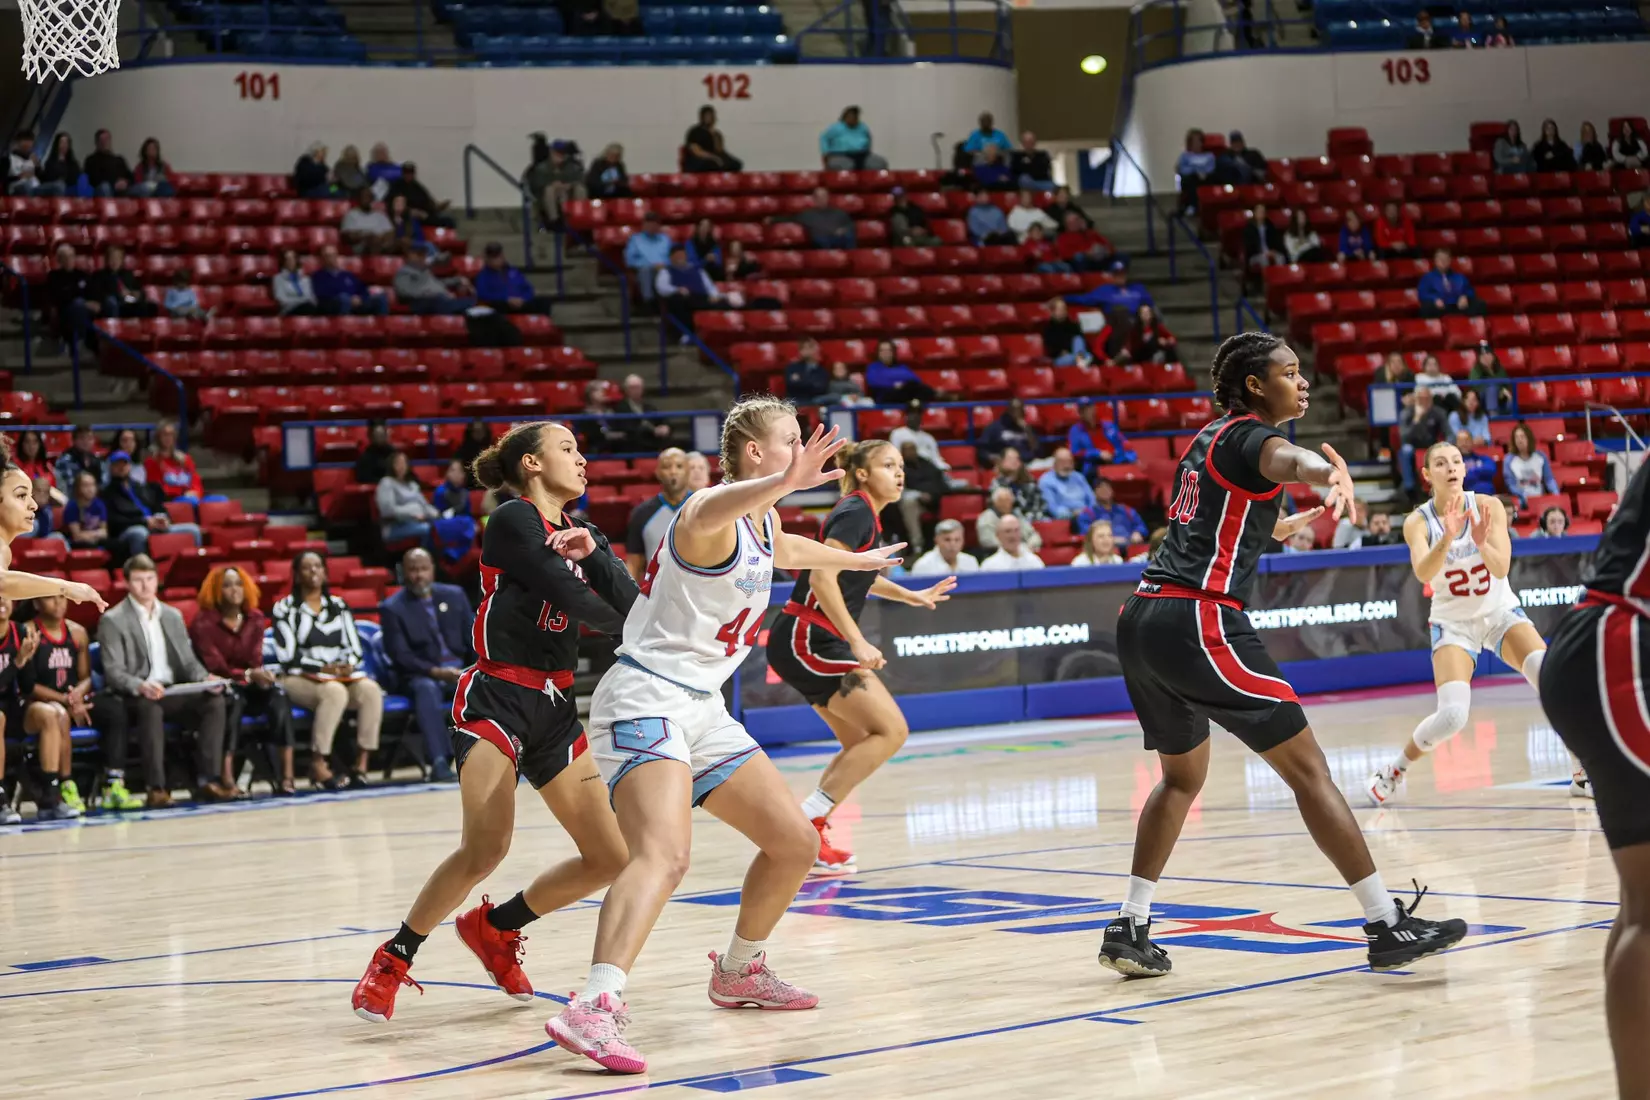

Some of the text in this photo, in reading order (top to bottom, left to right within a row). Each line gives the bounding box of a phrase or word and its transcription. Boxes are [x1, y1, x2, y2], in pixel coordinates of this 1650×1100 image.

[233, 71, 280, 101] 101
[702, 72, 752, 100] 102
[1381, 57, 1431, 85] 103
[1169, 468, 1199, 524] 10
[1445, 563, 1491, 596] 23
[537, 600, 568, 632] 13
[1246, 600, 1398, 630] CKETSFORLESS.COM
[893, 623, 1090, 657] TICKETSFORLESS.COM
